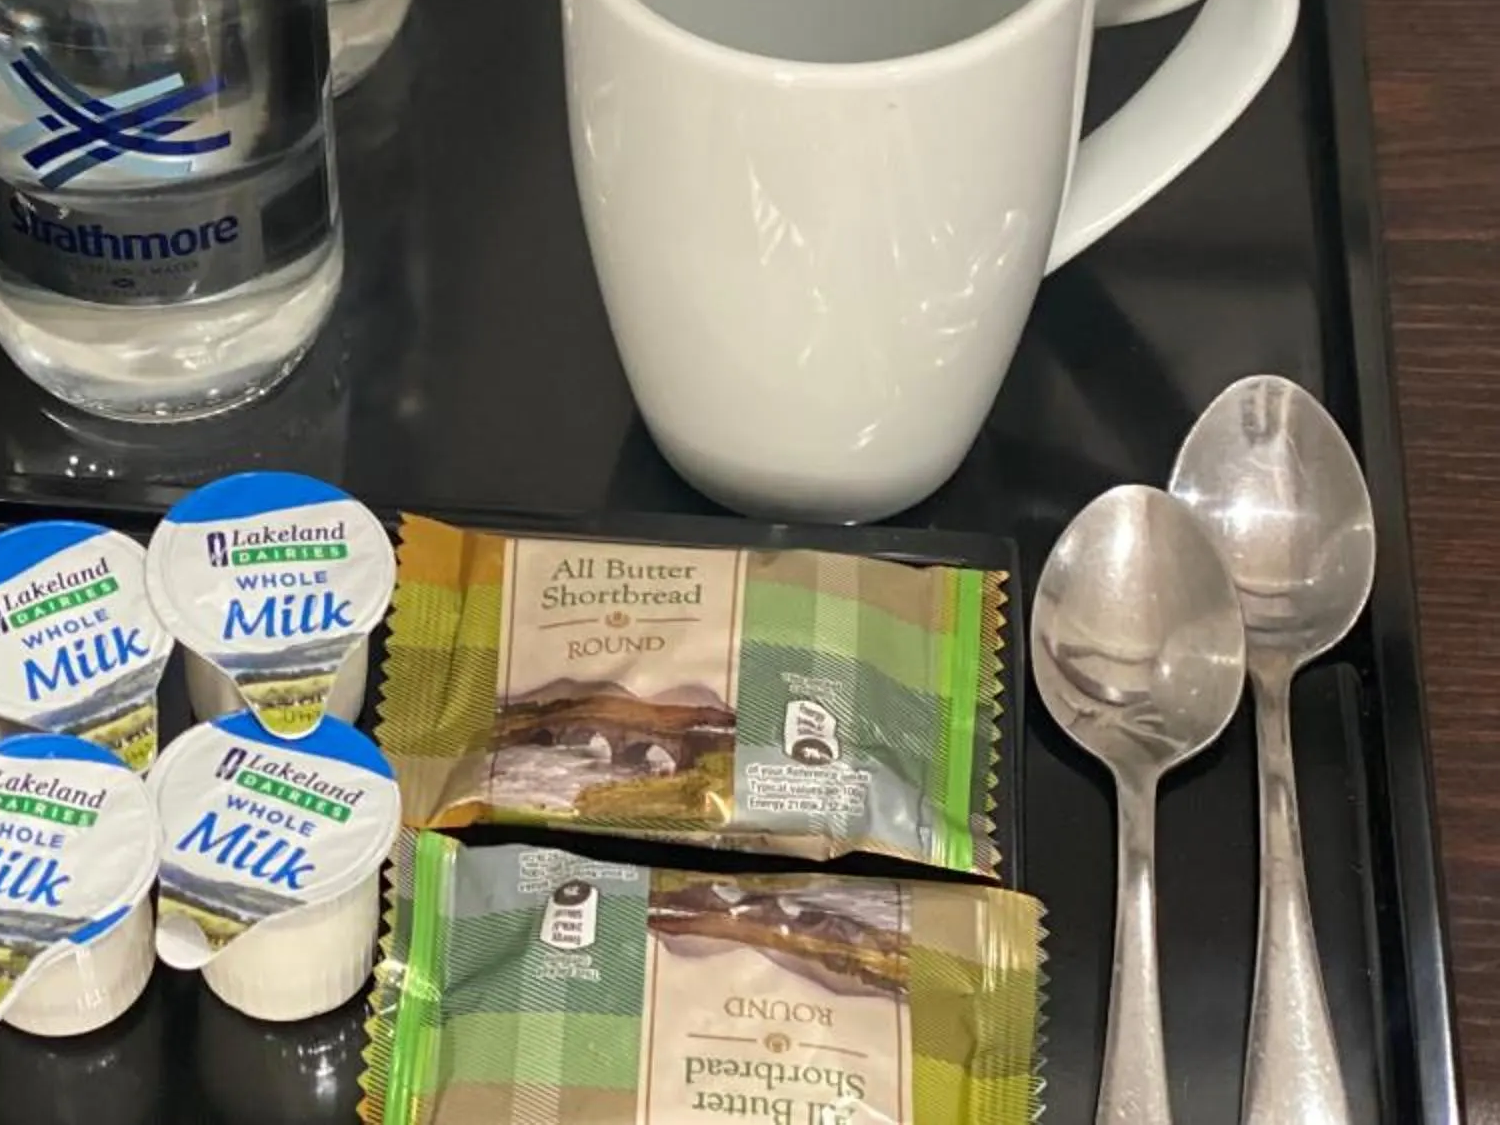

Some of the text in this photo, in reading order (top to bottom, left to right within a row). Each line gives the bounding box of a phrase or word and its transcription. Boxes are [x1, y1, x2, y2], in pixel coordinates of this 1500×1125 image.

[9, 193, 238, 261] Strathmore
[232, 520, 346, 548] Lakeland
[239, 546, 341, 562] DAIRIES
[3, 557, 110, 611] Lakeland
[235, 569, 329, 591] WHOLE
[550, 557, 698, 582] All Butter
[15, 580, 113, 625] DAIRIES
[222, 590, 356, 640] Milk
[541, 583, 704, 611] Shortbread
[21, 607, 111, 651] WHOLE
[566, 635, 667, 661] ROUND
[23, 625, 150, 702] Milk
[242, 772, 344, 819] DAIRIES
[247, 753, 366, 807] Lakeland
[226, 793, 319, 838] WHOLE
[176, 810, 316, 891] Milk
[723, 995, 834, 1028] ROUND
[684, 1055, 866, 1101] Shortbread
[690, 1089, 795, 1125] Butter
